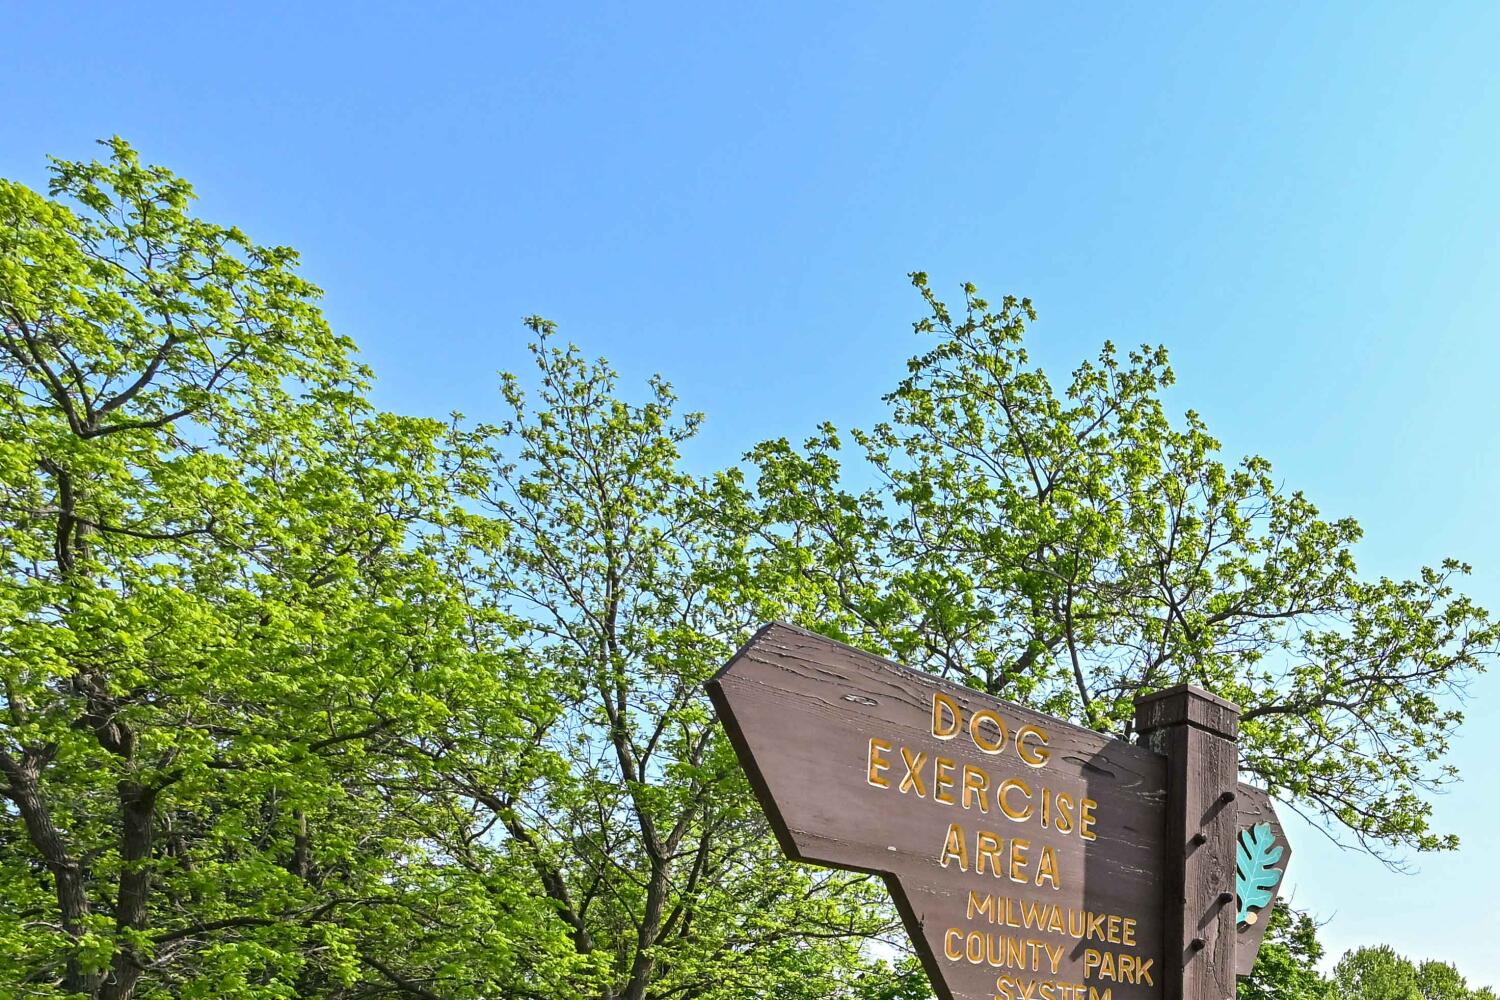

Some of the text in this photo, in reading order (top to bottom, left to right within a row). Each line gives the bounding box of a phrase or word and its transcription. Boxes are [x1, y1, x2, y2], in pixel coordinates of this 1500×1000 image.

[931, 692, 1051, 768] DOG
[867, 738, 1098, 841] EXERCISE
[940, 823, 1061, 890] AREA
[966, 889, 1137, 946] MILWAUKEE
[944, 927, 1154, 986] COUNTY PARK
